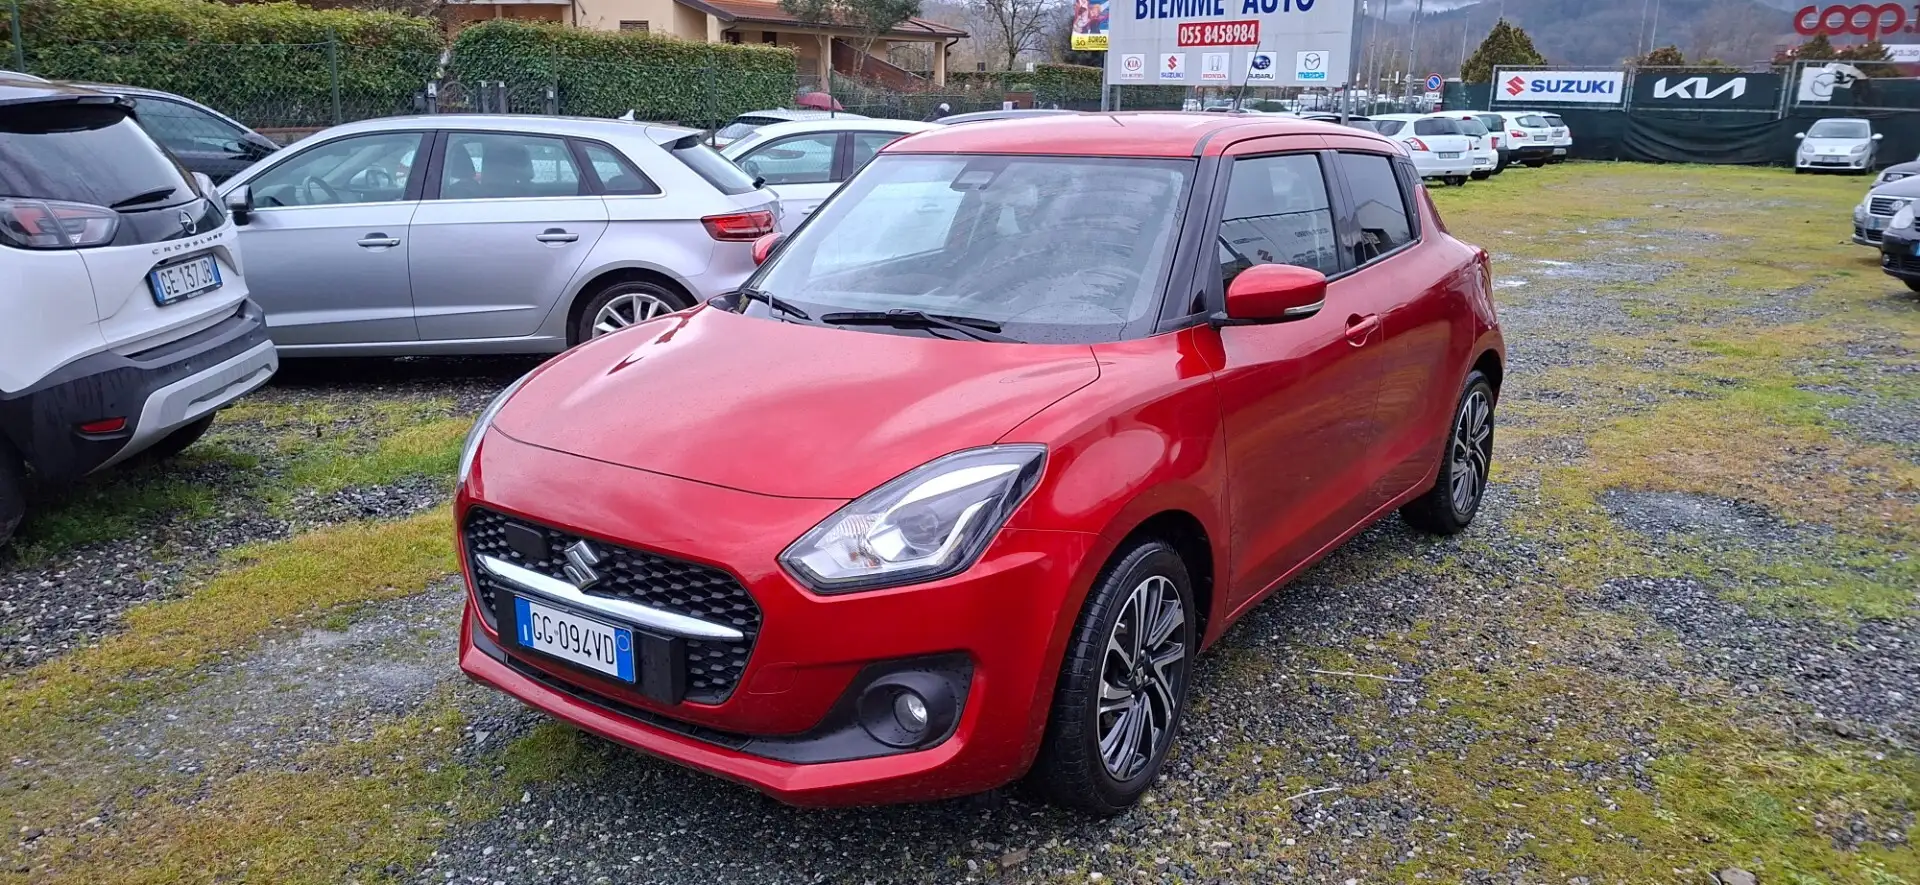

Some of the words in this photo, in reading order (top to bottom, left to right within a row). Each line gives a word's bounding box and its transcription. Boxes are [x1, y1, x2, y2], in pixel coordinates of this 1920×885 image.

[1136, 0, 1224, 19] BIEMME
[1180, 26, 1201, 44] 055
[1204, 23, 1256, 43] 8458984
[1127, 60, 1139, 68] KIA
[1298, 71, 1325, 79] mazda
[1531, 79, 1614, 94] SUZUKI
[161, 269, 179, 296] GE
[532, 612, 553, 645] GG
